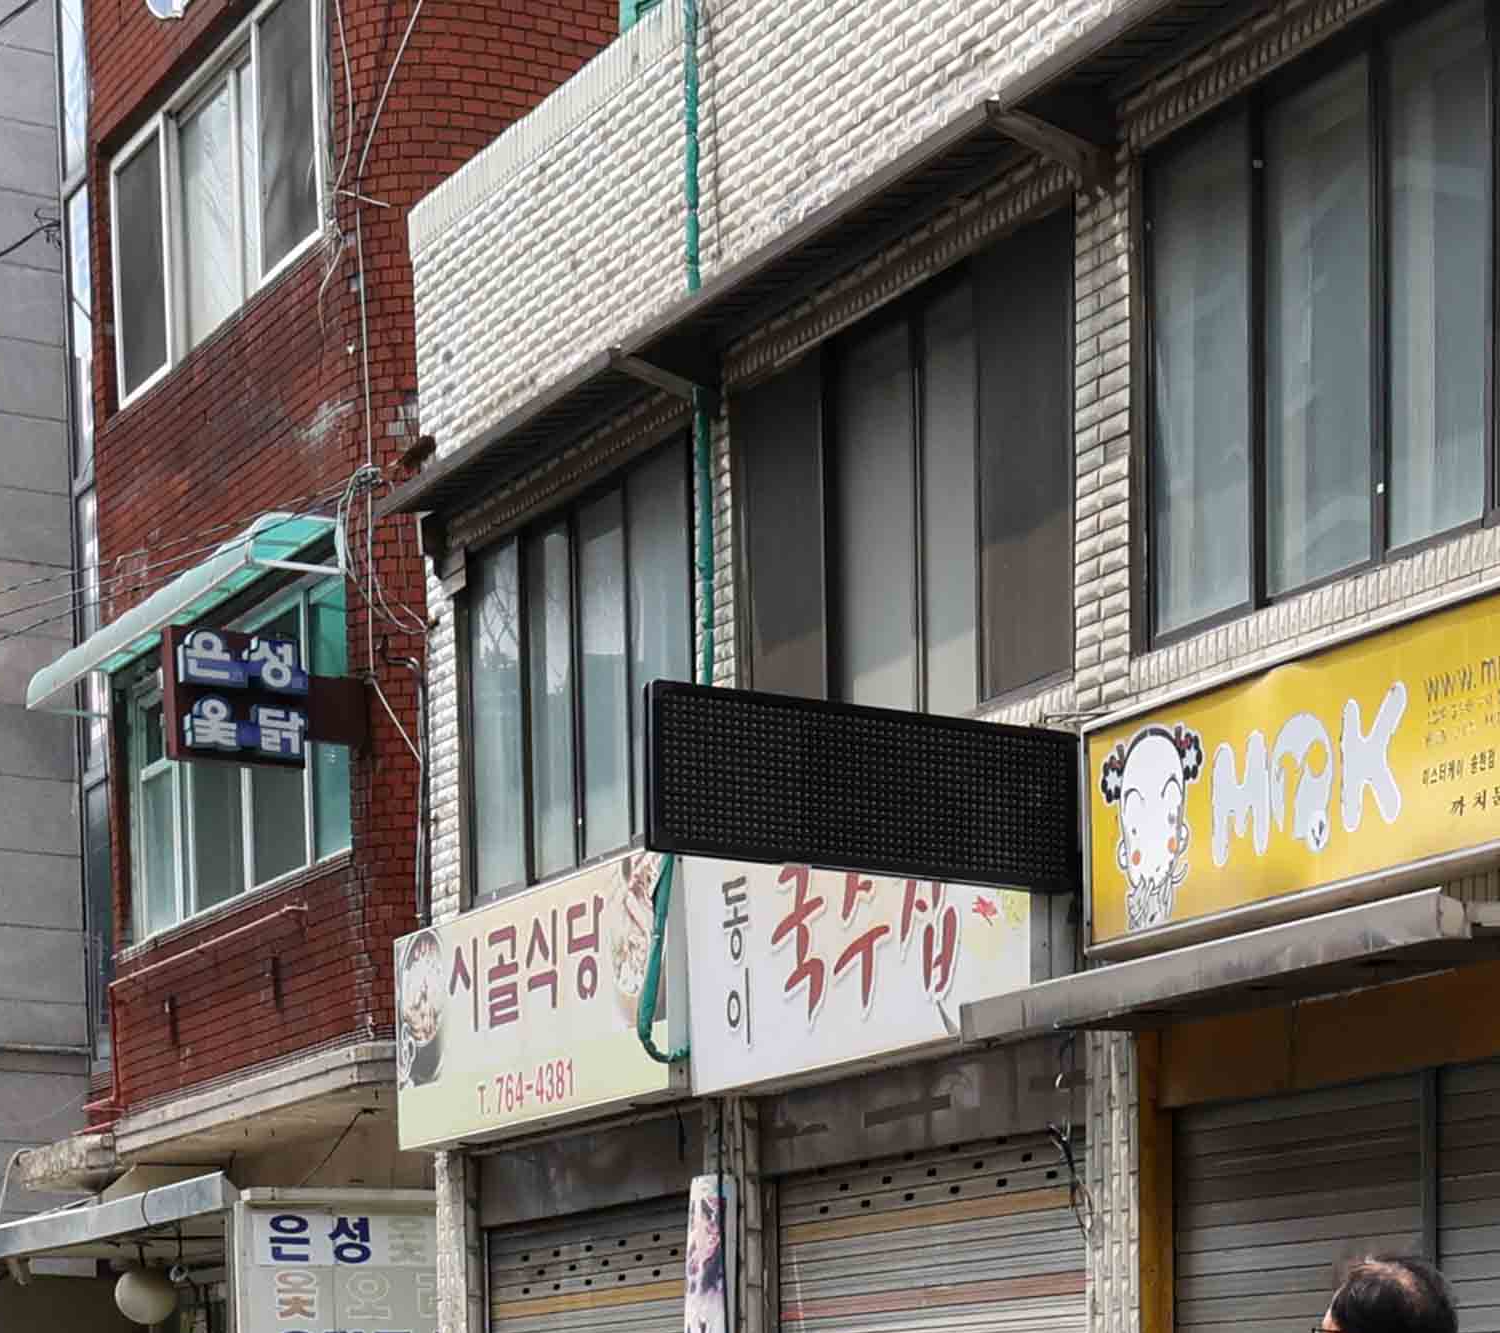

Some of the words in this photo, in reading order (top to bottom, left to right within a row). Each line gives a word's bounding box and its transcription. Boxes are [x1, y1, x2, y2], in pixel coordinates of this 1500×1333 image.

[178, 630, 293, 688] 은성
[448, 895, 606, 1034] 시골식당
[495, 1057, 577, 1112] 764-4381
[269, 1214, 372, 1264] 은성
